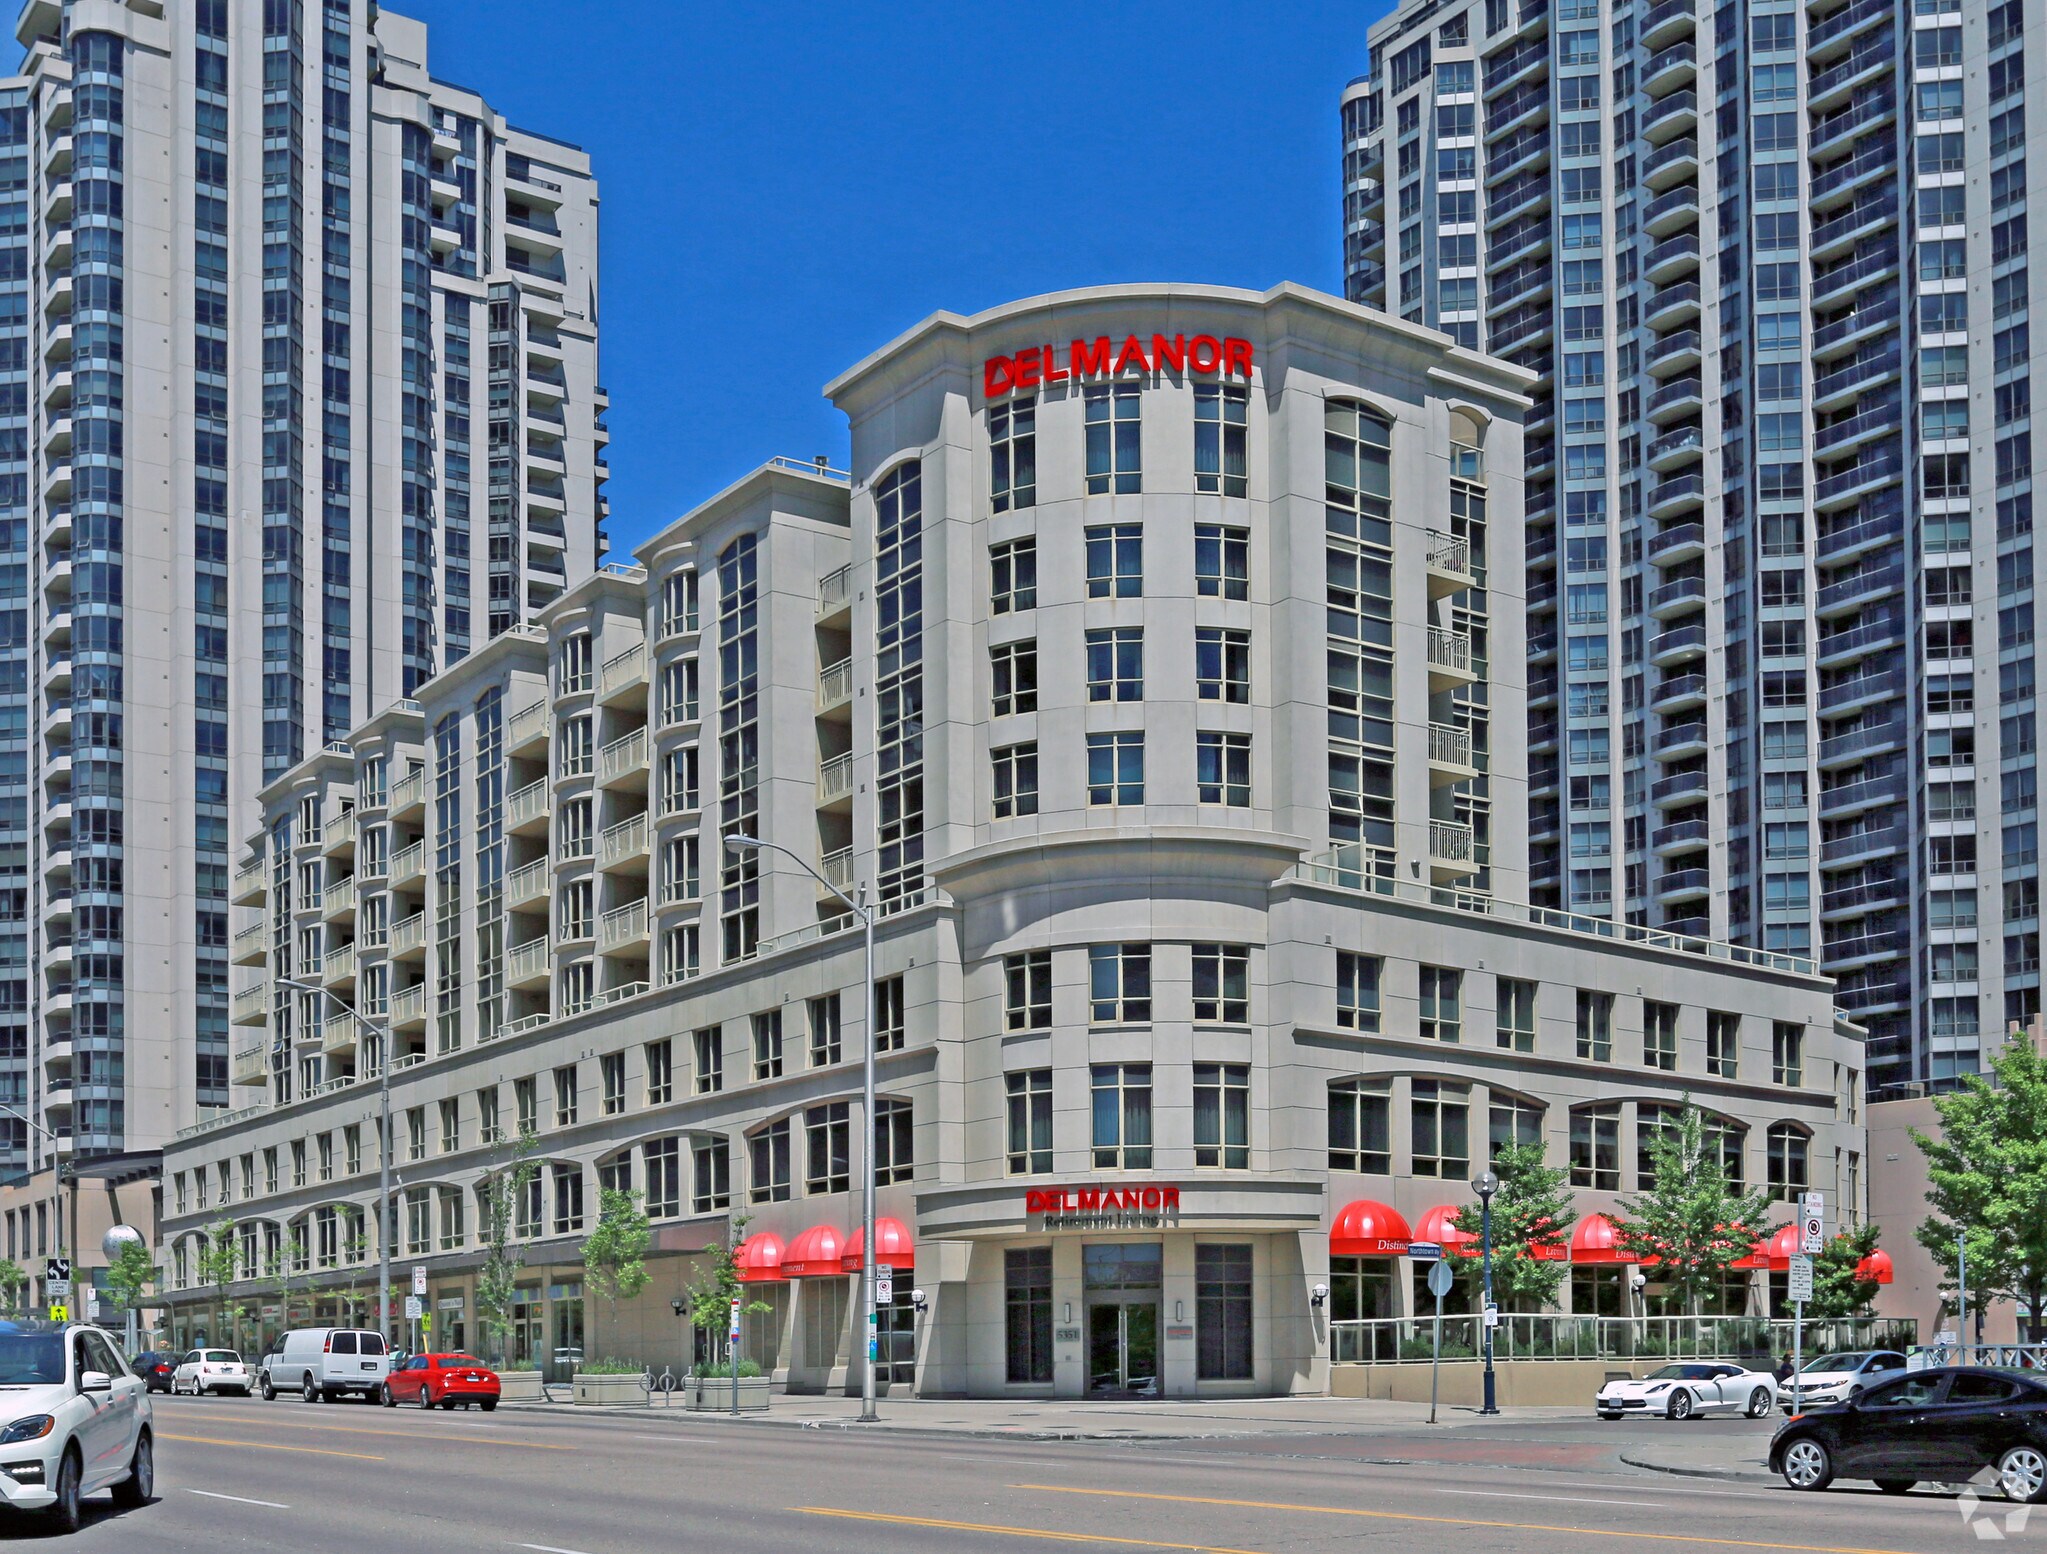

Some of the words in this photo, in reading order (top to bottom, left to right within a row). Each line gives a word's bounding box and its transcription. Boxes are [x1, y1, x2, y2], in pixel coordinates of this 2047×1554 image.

[984, 334, 1254, 398] DELMANOR
[1026, 1187, 1180, 1213] DELMANOR
[1044, 1215, 1112, 1228] Retirement
[1117, 1214, 1159, 1227] Living
[1058, 1330, 1078, 1339] 5351
